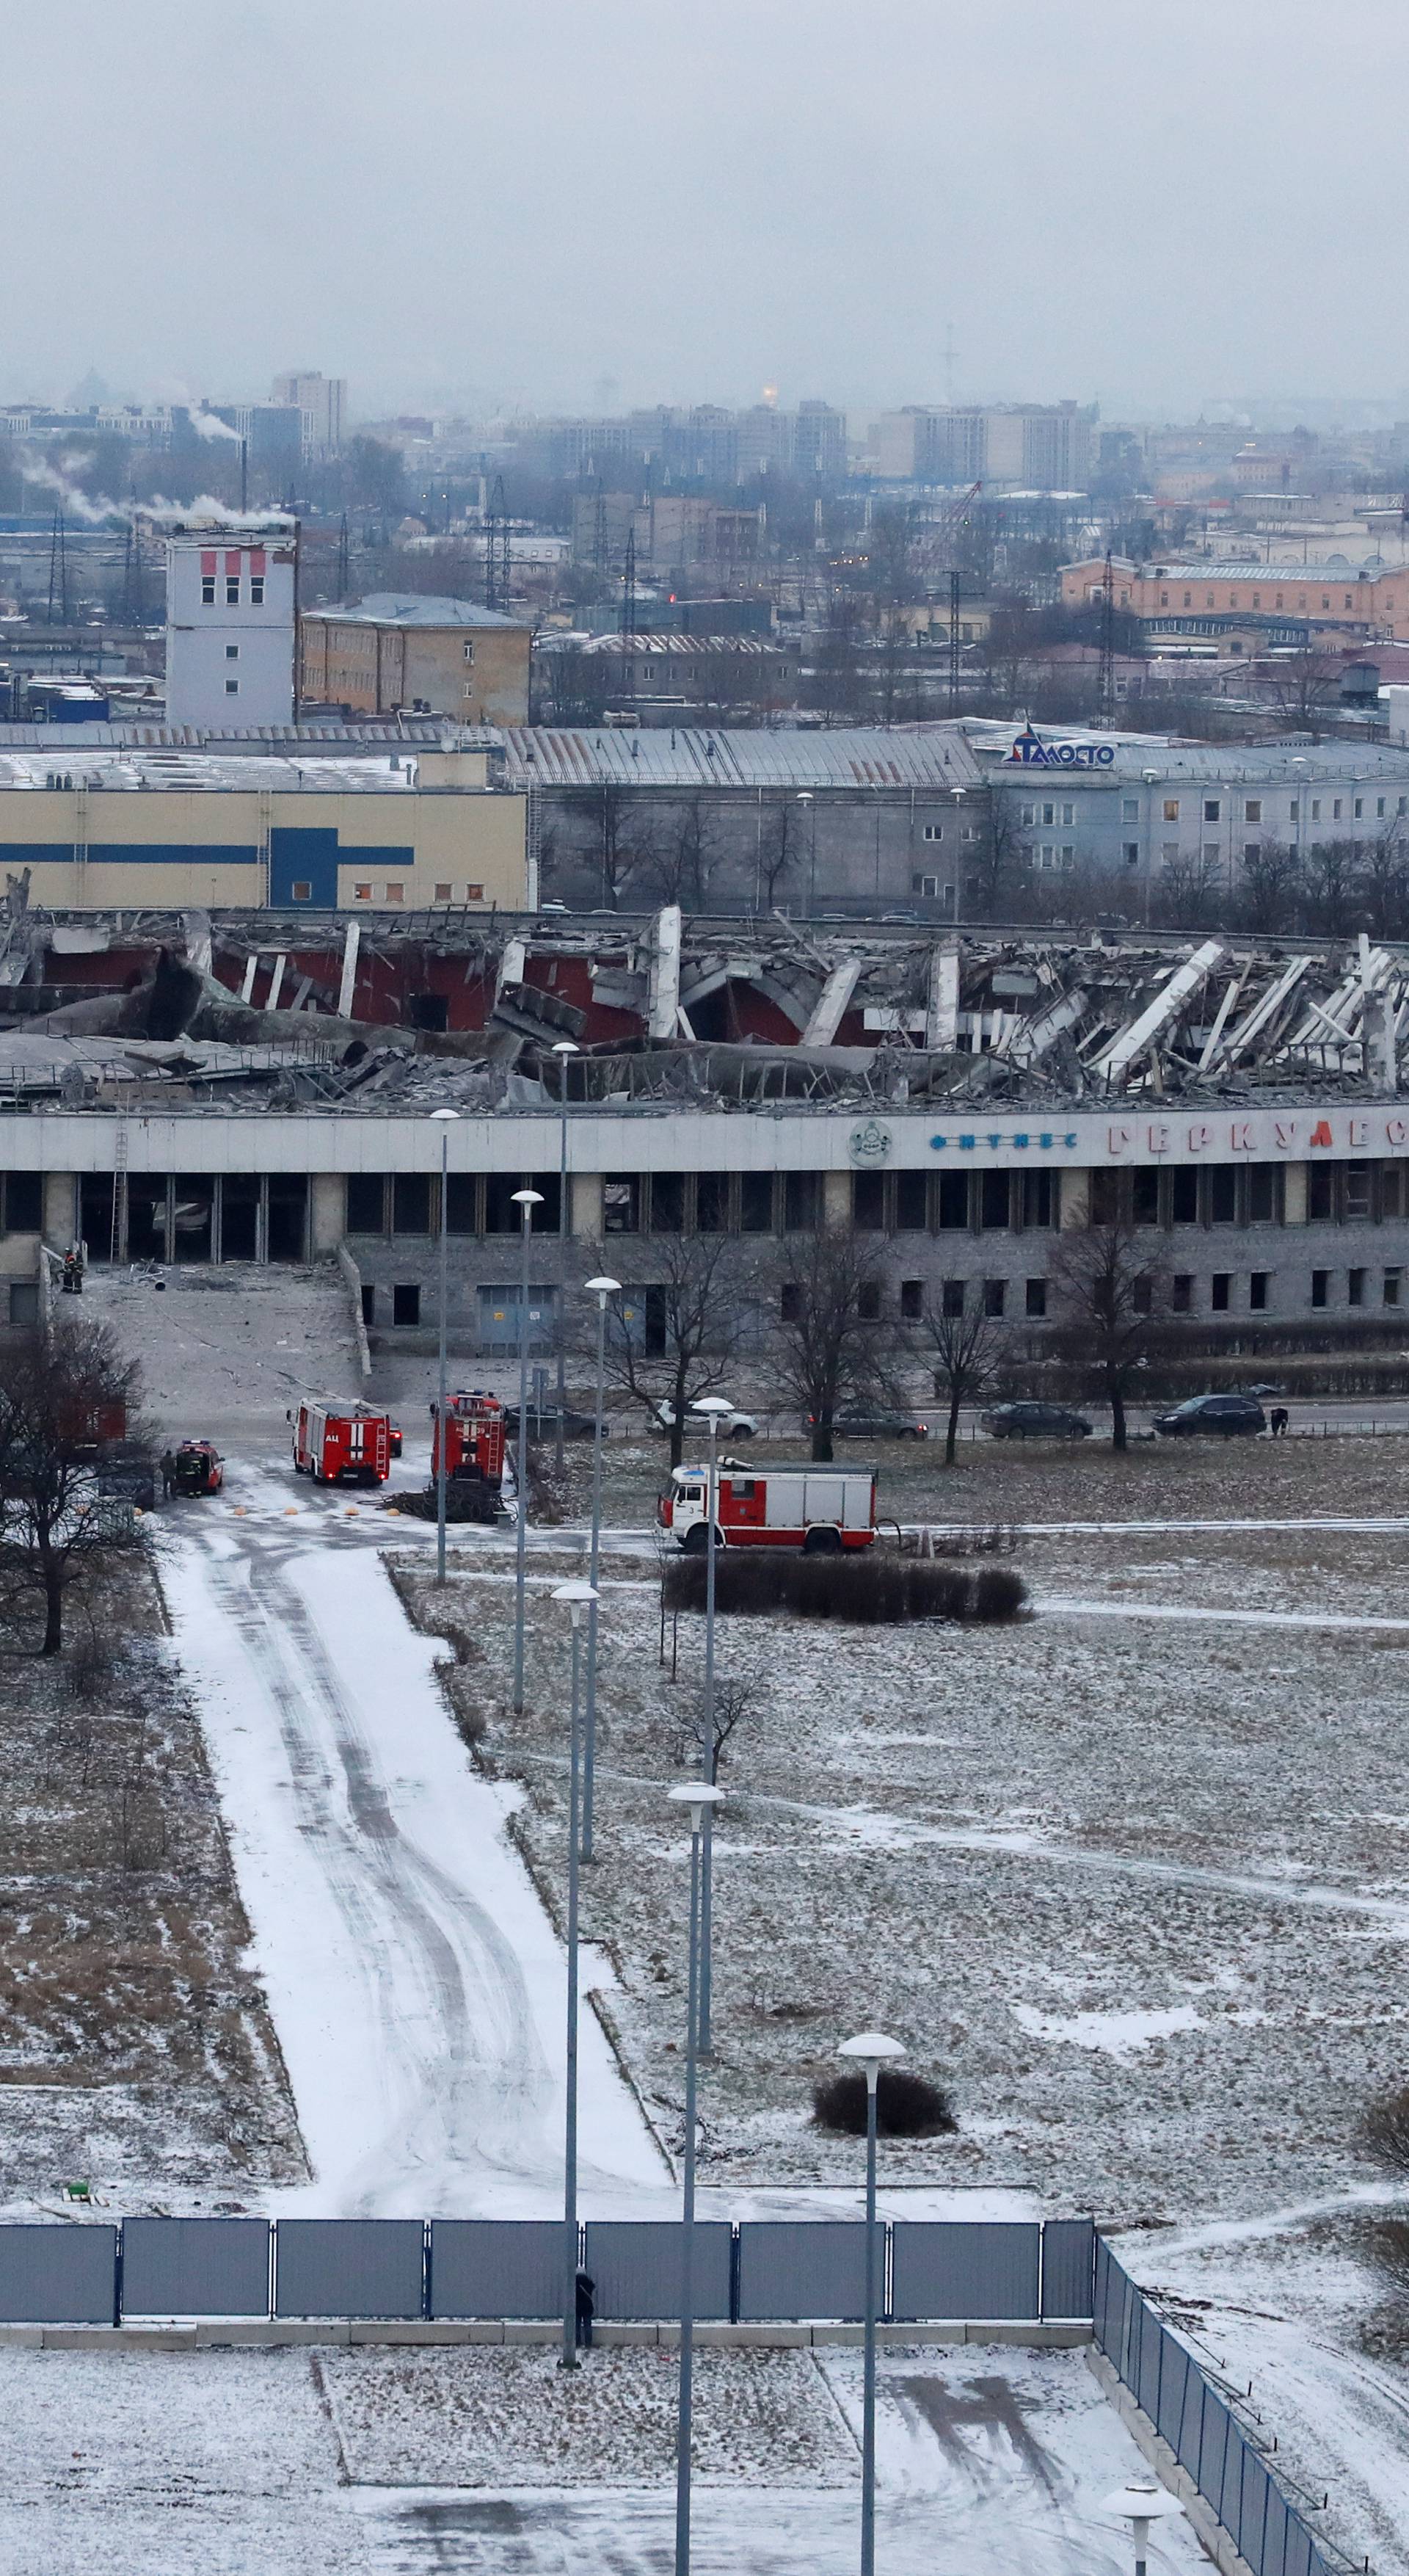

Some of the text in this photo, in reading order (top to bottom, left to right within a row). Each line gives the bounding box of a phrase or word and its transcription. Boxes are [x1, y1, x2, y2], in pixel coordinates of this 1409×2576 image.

[1011, 737, 1115, 764] ТАЛОСТО
[930, 1120, 1409, 1153] ФИТНЕС ГЕРКУЛЕС
[325, 1434, 339, 1443] АЦ
